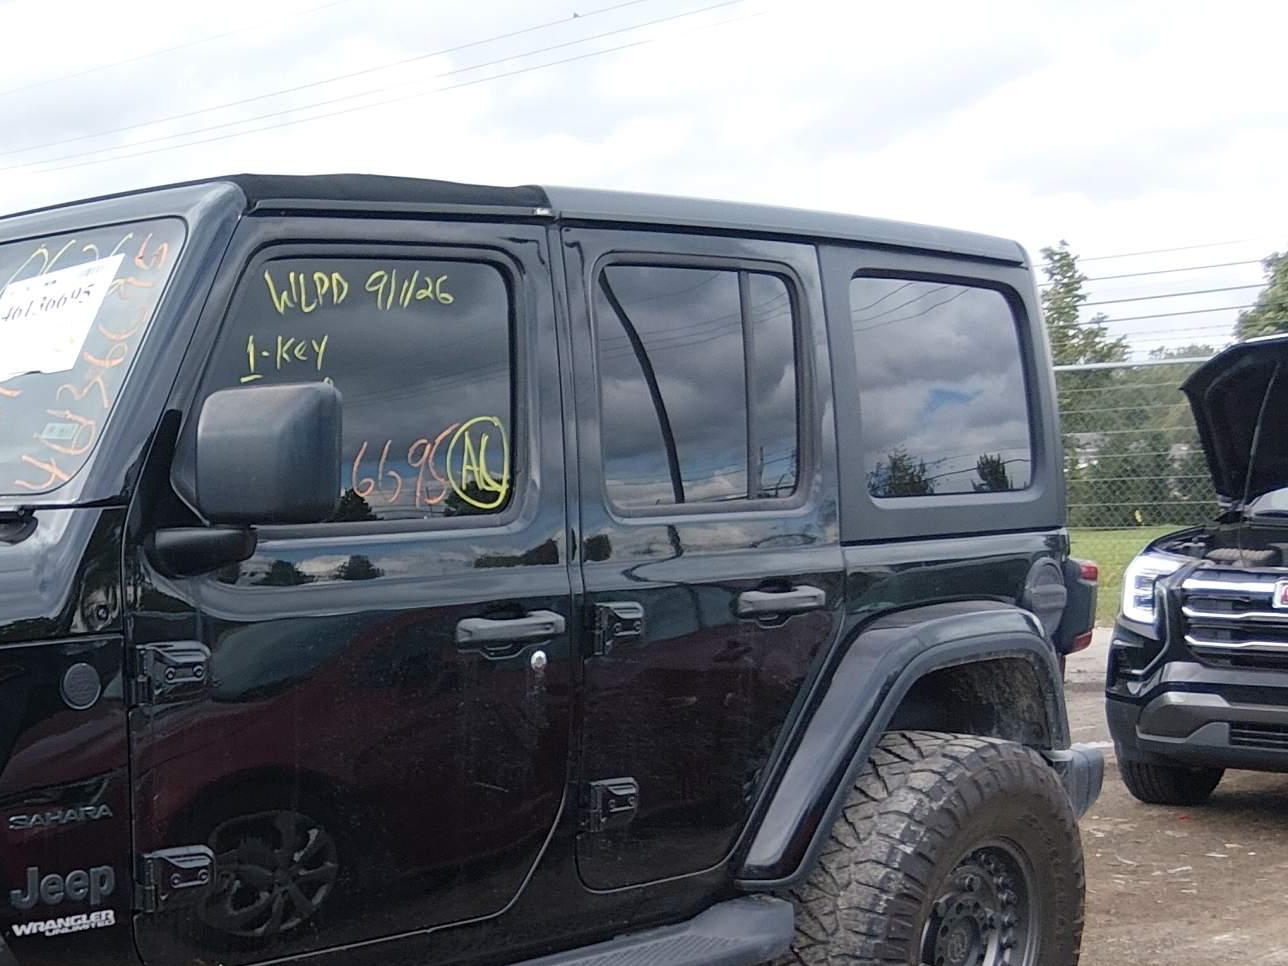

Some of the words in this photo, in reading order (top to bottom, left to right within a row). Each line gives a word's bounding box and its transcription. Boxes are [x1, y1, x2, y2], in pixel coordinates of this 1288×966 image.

[364, 266, 455, 311] 9/1/26
[9, 805, 113, 830] SAHARA
[10, 865, 116, 909] Jeep
[12, 909, 115, 937] WRANGLER
[45, 919, 116, 937] UNLIMITED
